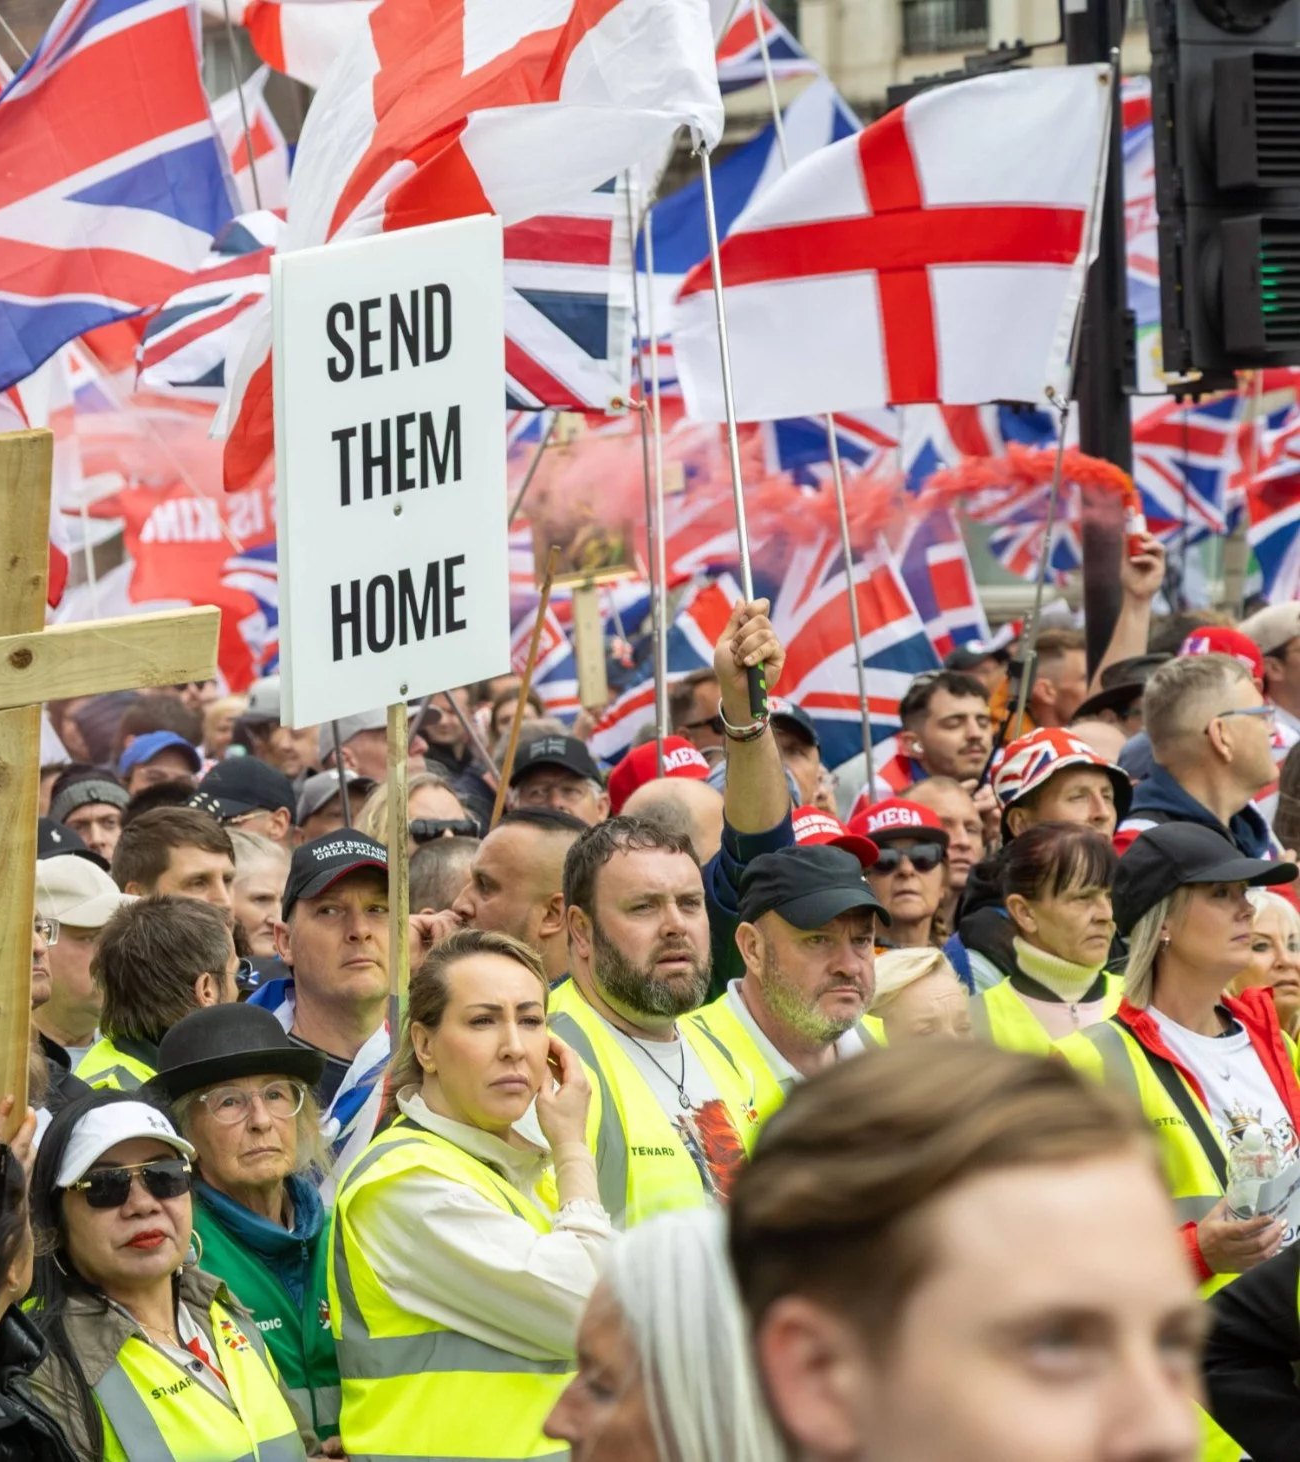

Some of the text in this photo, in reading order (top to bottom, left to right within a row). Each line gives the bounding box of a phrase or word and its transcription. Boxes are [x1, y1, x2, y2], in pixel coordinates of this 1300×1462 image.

[326, 282, 452, 382] SEND
[331, 404, 462, 512] THEM
[331, 553, 467, 663] HOME
[867, 806, 924, 833] MEGA
[312, 840, 387, 857] MAKE BRITAIN
[316, 847, 387, 863] GREAT AGAIN
[630, 1145, 675, 1157] TEWARD
